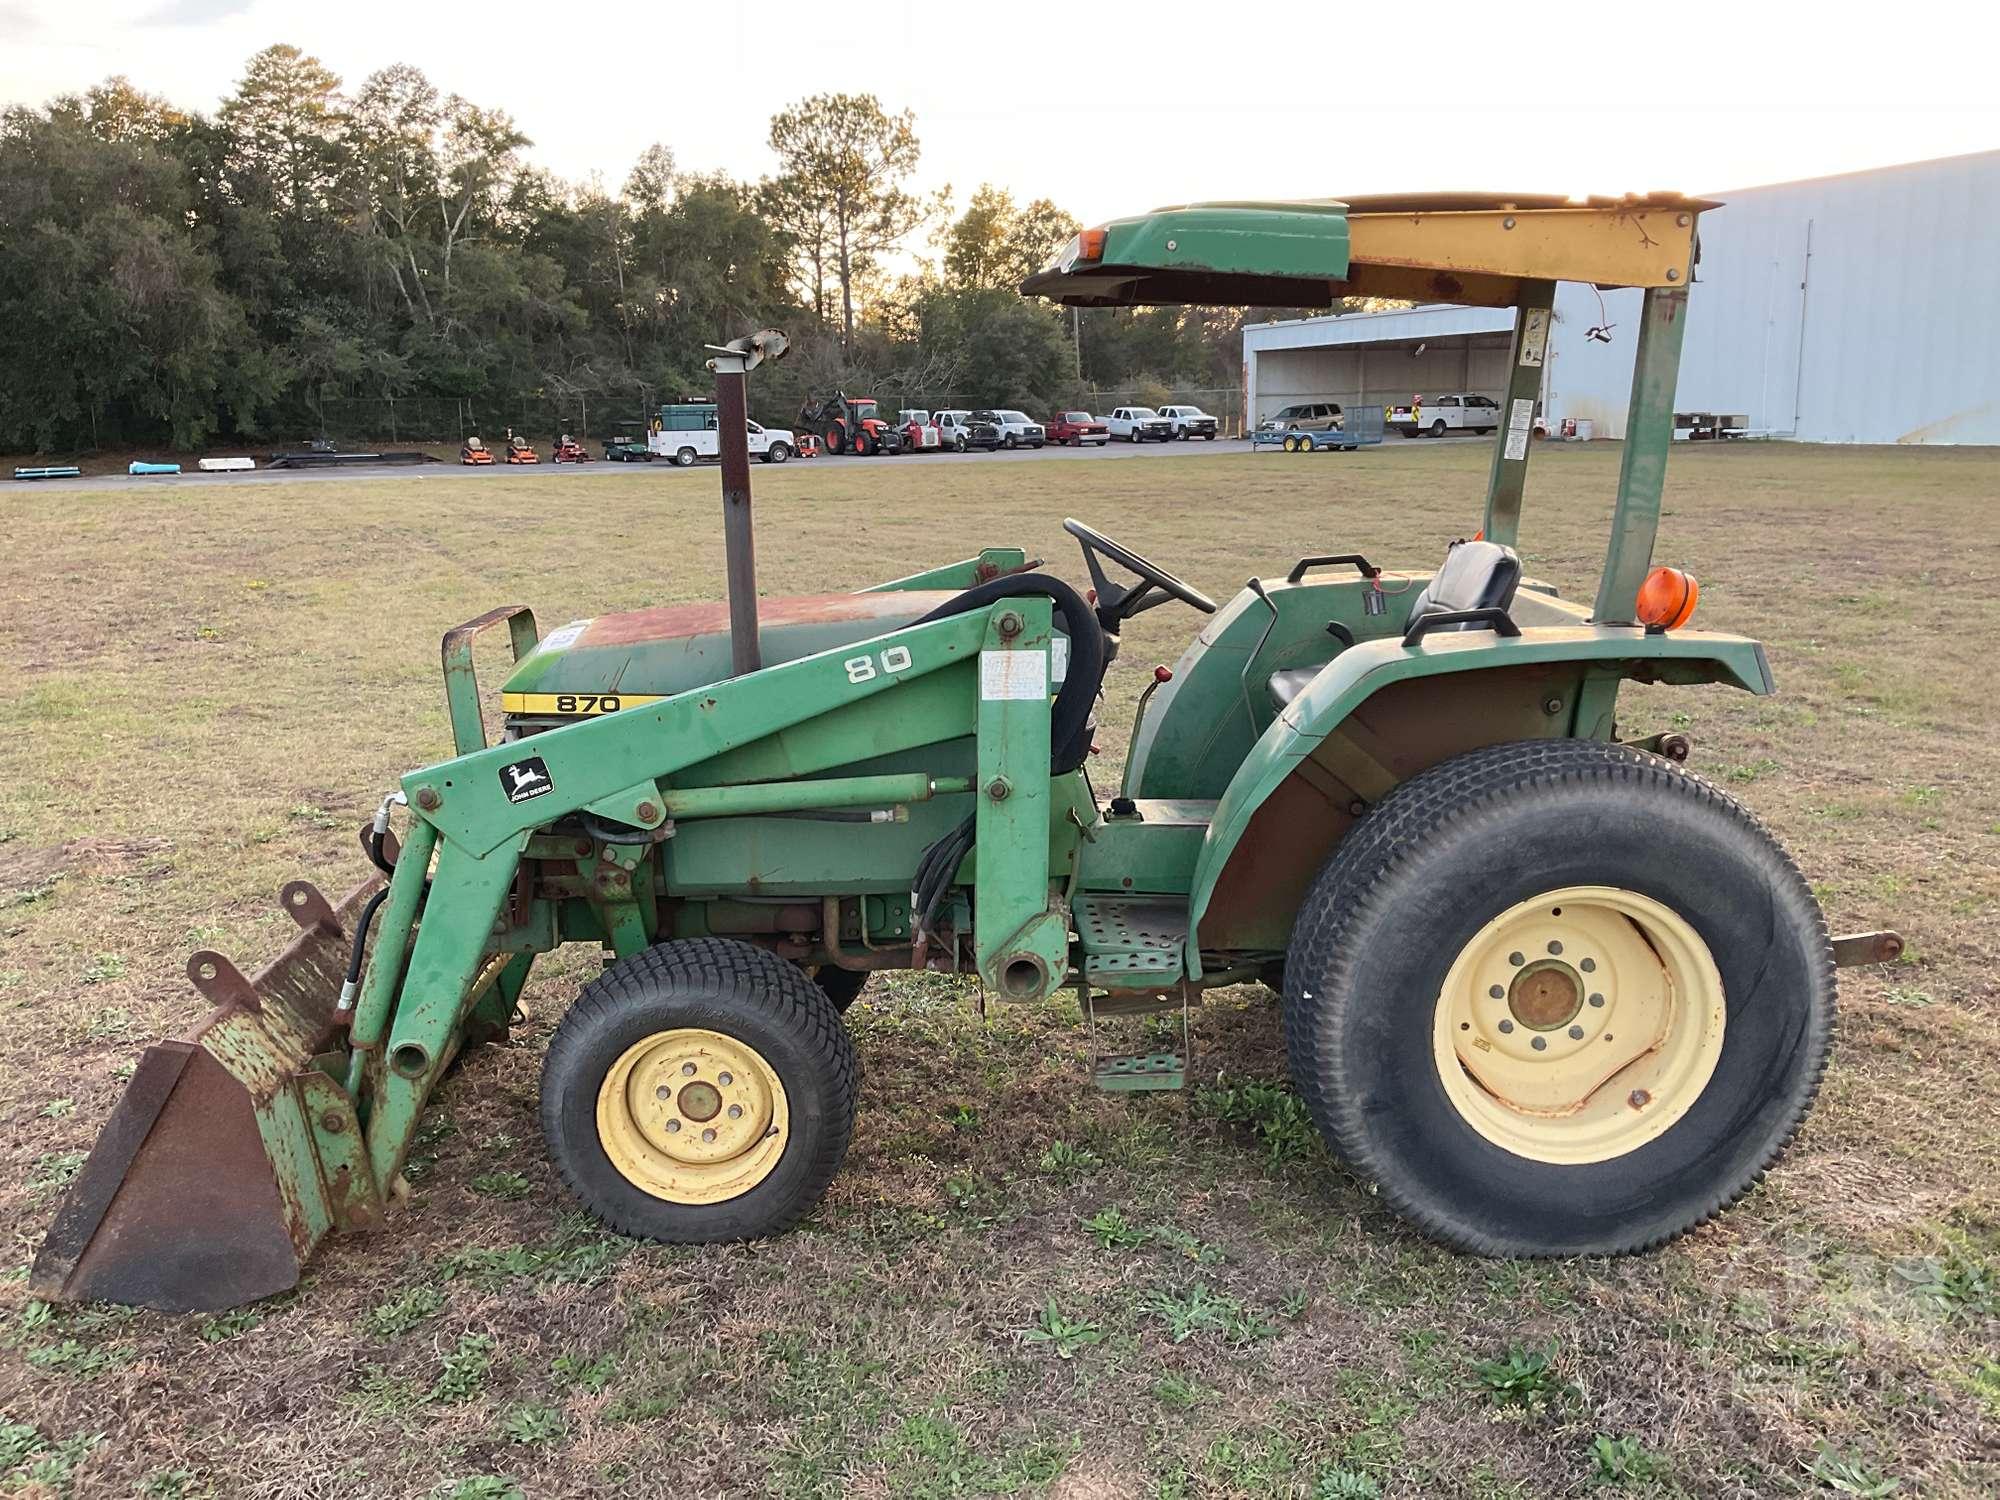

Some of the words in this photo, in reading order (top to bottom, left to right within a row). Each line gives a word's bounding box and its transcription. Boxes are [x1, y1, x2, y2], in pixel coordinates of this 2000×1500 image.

[844, 645, 913, 684] 80
[557, 696, 620, 712] 870
[511, 791, 530, 802] JOHN
[529, 783, 552, 797] DEERE
